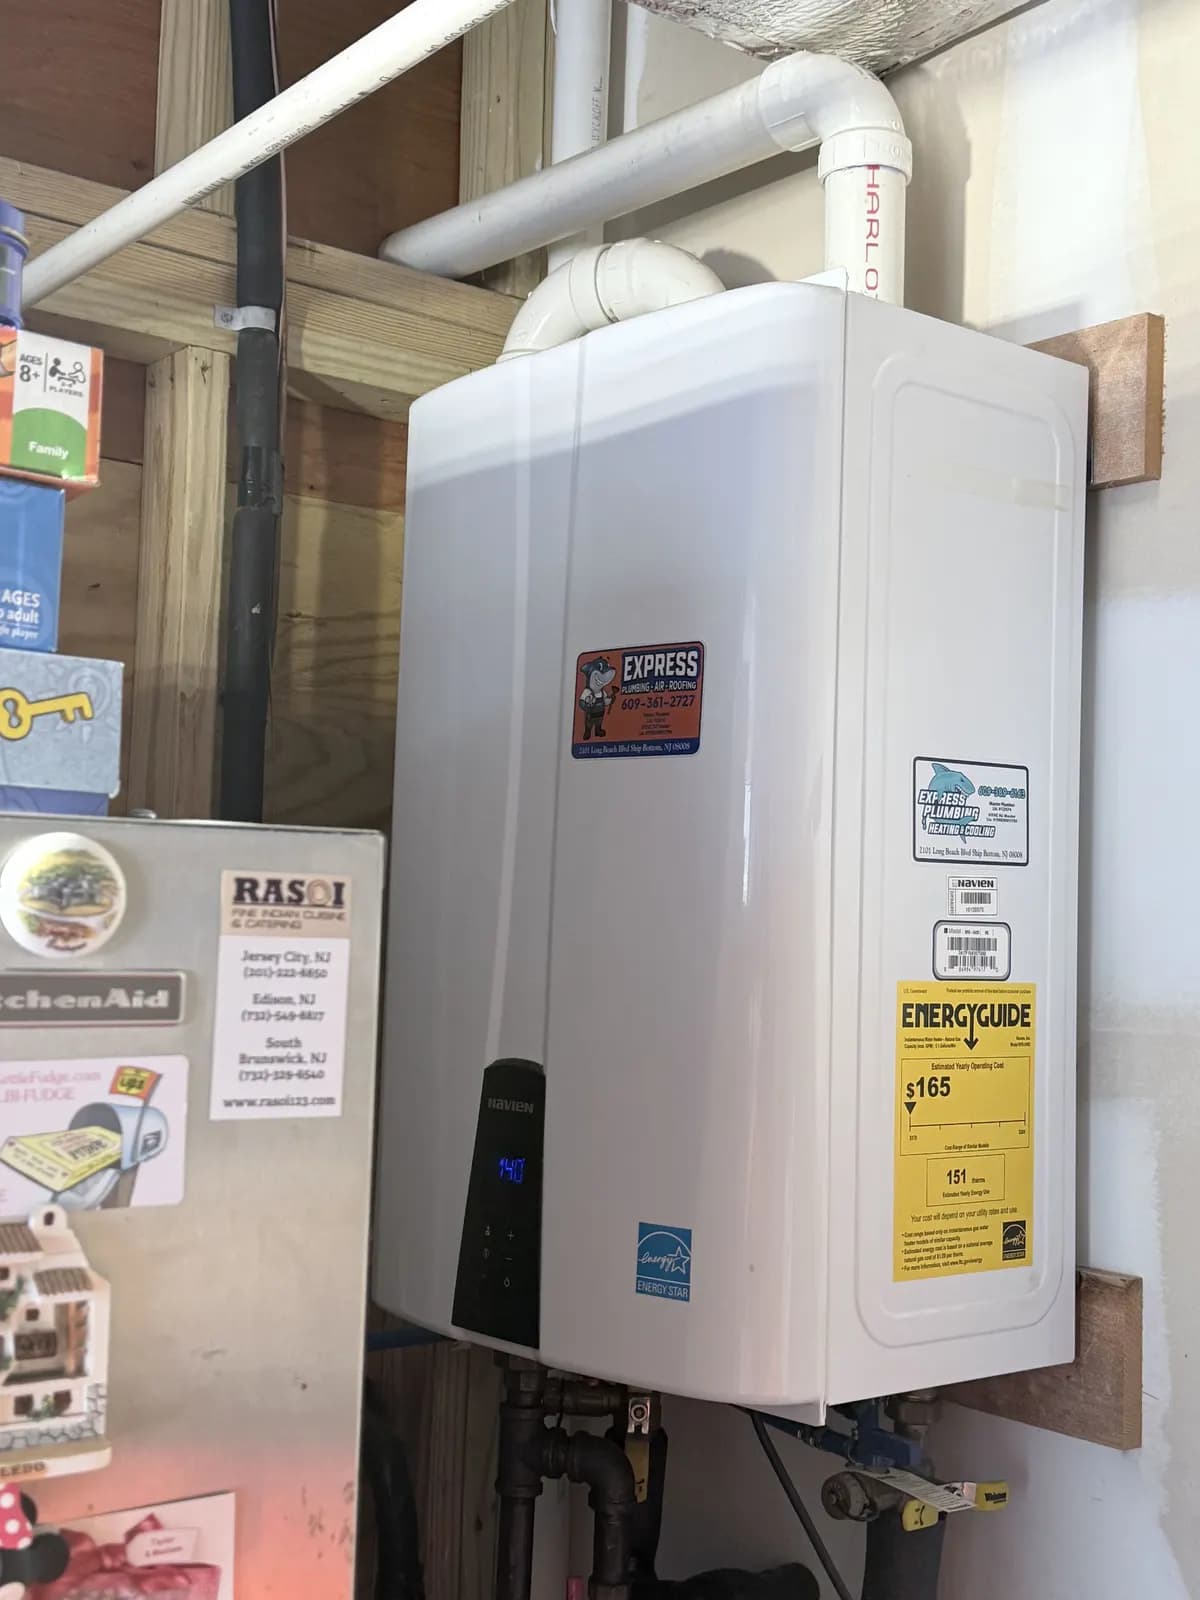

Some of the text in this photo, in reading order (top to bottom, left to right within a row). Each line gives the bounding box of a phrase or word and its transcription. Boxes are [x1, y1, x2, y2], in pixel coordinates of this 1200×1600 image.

[20, 354, 43, 366] AGES
[20, 365, 40, 382] 8+
[49, 386, 84, 397] PLAYERS
[28, 441, 69, 460] Family
[1, 588, 41, 608] AGES
[7, 607, 40, 624] adult
[623, 650, 699, 681] EXPRESS
[622, 680, 697, 693] PLUMBING AIR ROOFING
[621, 695, 695, 710] 609-361-2727
[919, 790, 967, 806] EXPRESS
[924, 804, 979, 821] PLUMBING
[928, 823, 960, 835] HEATING
[964, 824, 995, 837] COOLING
[232, 877, 345, 906] RASOI
[262, 909, 299, 919] INDIAN
[245, 919, 302, 930] CATERING
[241, 950, 281, 965] Jersey
[315, 952, 331, 963] NJ
[0, 987, 169, 1010] chenAid
[299, 993, 317, 1005] NJ
[902, 1003, 1031, 1028] ENERGYGUIDE
[266, 1037, 303, 1049] South
[311, 1052, 327, 1064] NJ
[931, 1061, 1004, 1072] Estimated Yearly Operating Cost
[906, 1076, 951, 1099] $165
[223, 1095, 336, 1107] www.rasoi123.com
[499, 1156, 525, 1184] 140
[947, 1168, 966, 1184] 151
[911, 1214, 921, 1222] Your
[922, 1214, 933, 1222] cost
[941, 1212, 958, 1221] depend
[965, 1211, 976, 1220] your
[637, 1280, 689, 1300] ENERGY STAR
